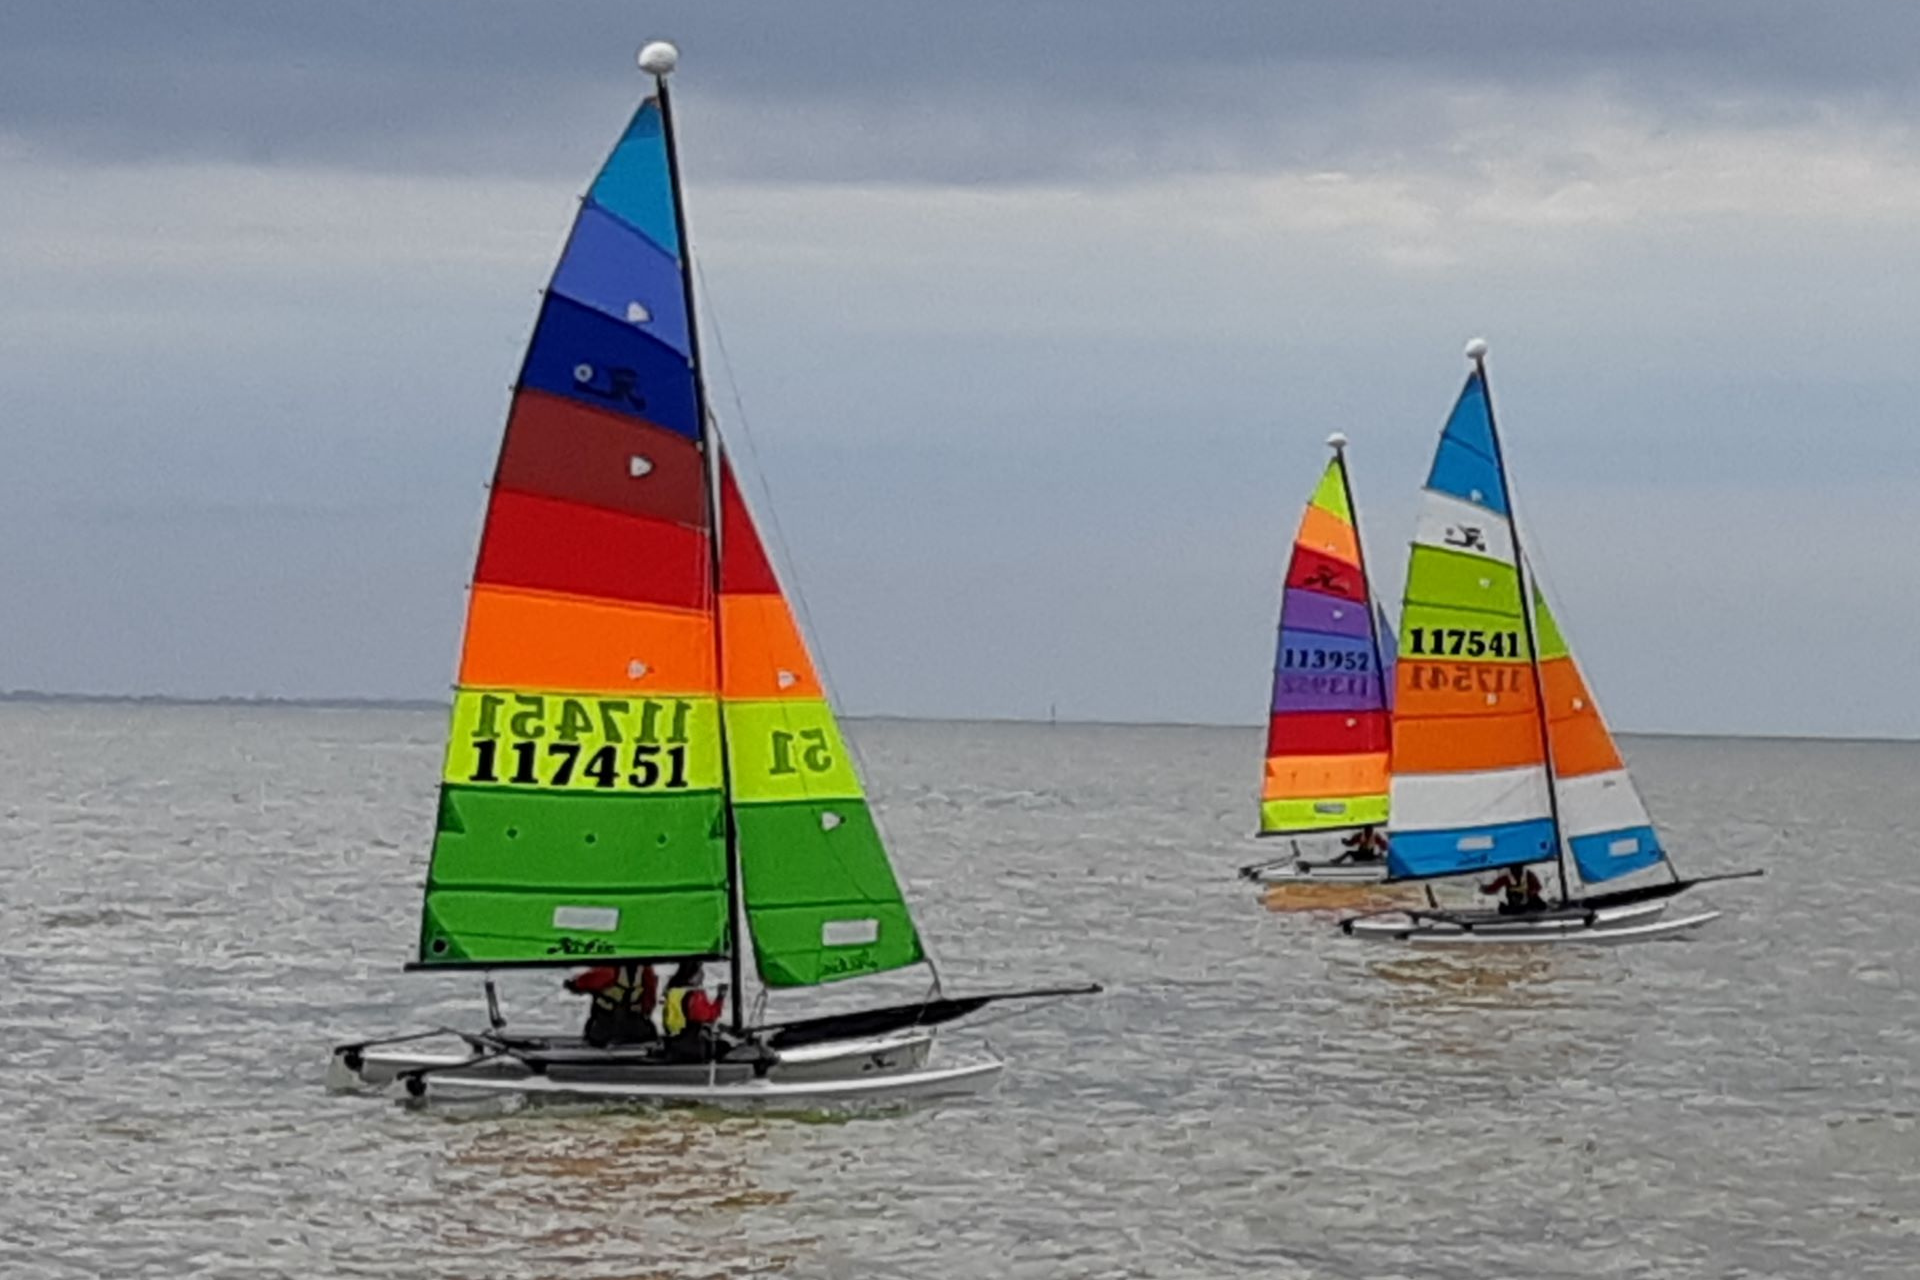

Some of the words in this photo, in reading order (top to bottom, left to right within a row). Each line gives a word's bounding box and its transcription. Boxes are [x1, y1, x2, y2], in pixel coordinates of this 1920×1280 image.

[1410, 628, 1520, 658] 117541
[1284, 648, 1369, 671] 113952
[471, 740, 688, 787] 117451
